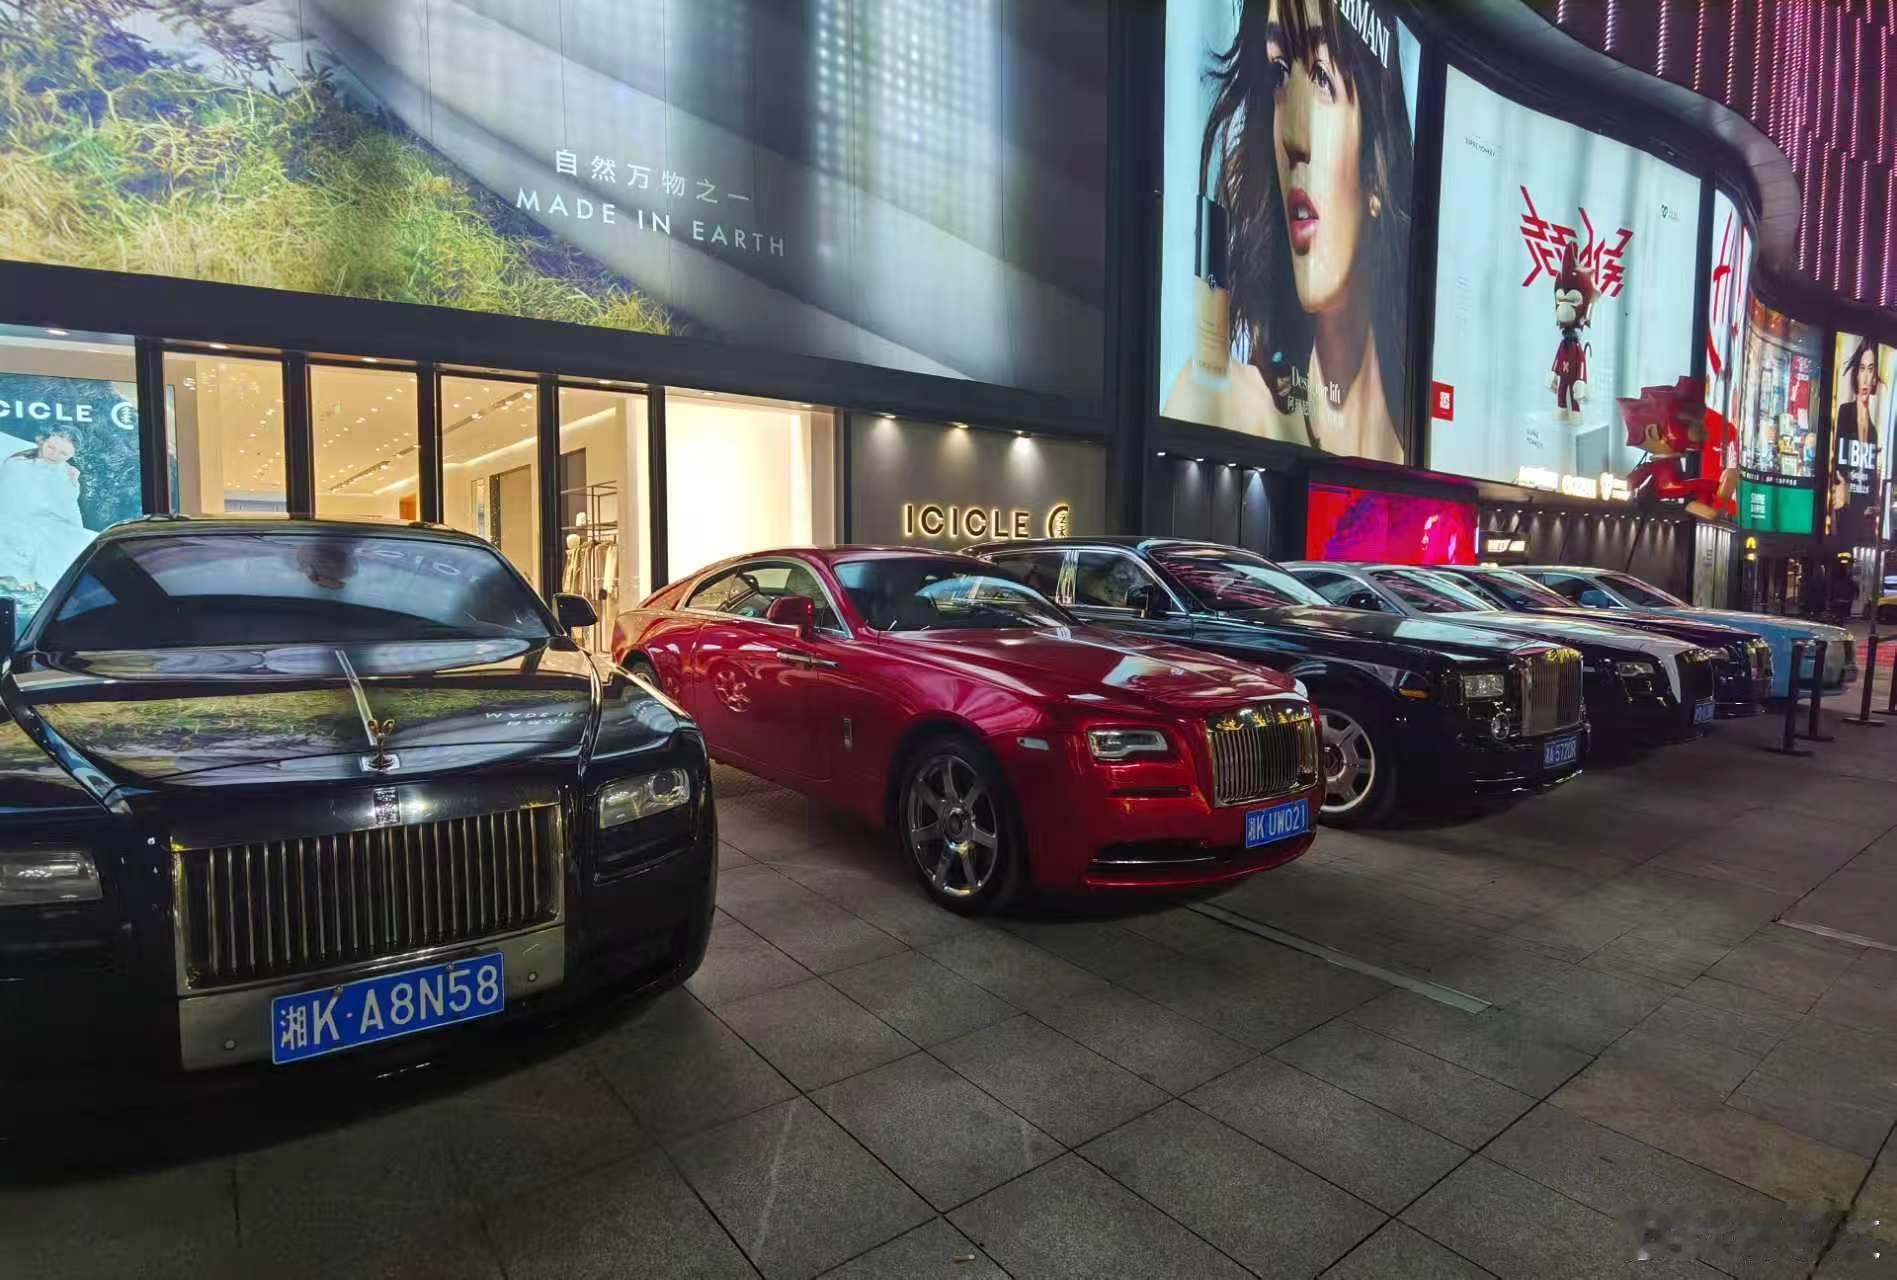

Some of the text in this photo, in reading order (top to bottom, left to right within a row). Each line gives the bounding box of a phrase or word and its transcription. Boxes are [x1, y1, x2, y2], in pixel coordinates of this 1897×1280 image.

[1339, 0, 1390, 69] RMANI
[555, 149, 750, 204] 自然万物之一
[516, 187, 784, 257] MADE IN EARTH
[904, 504, 1030, 539] ICICLE
[280, 964, 500, 1051] 湘K·A8N58
